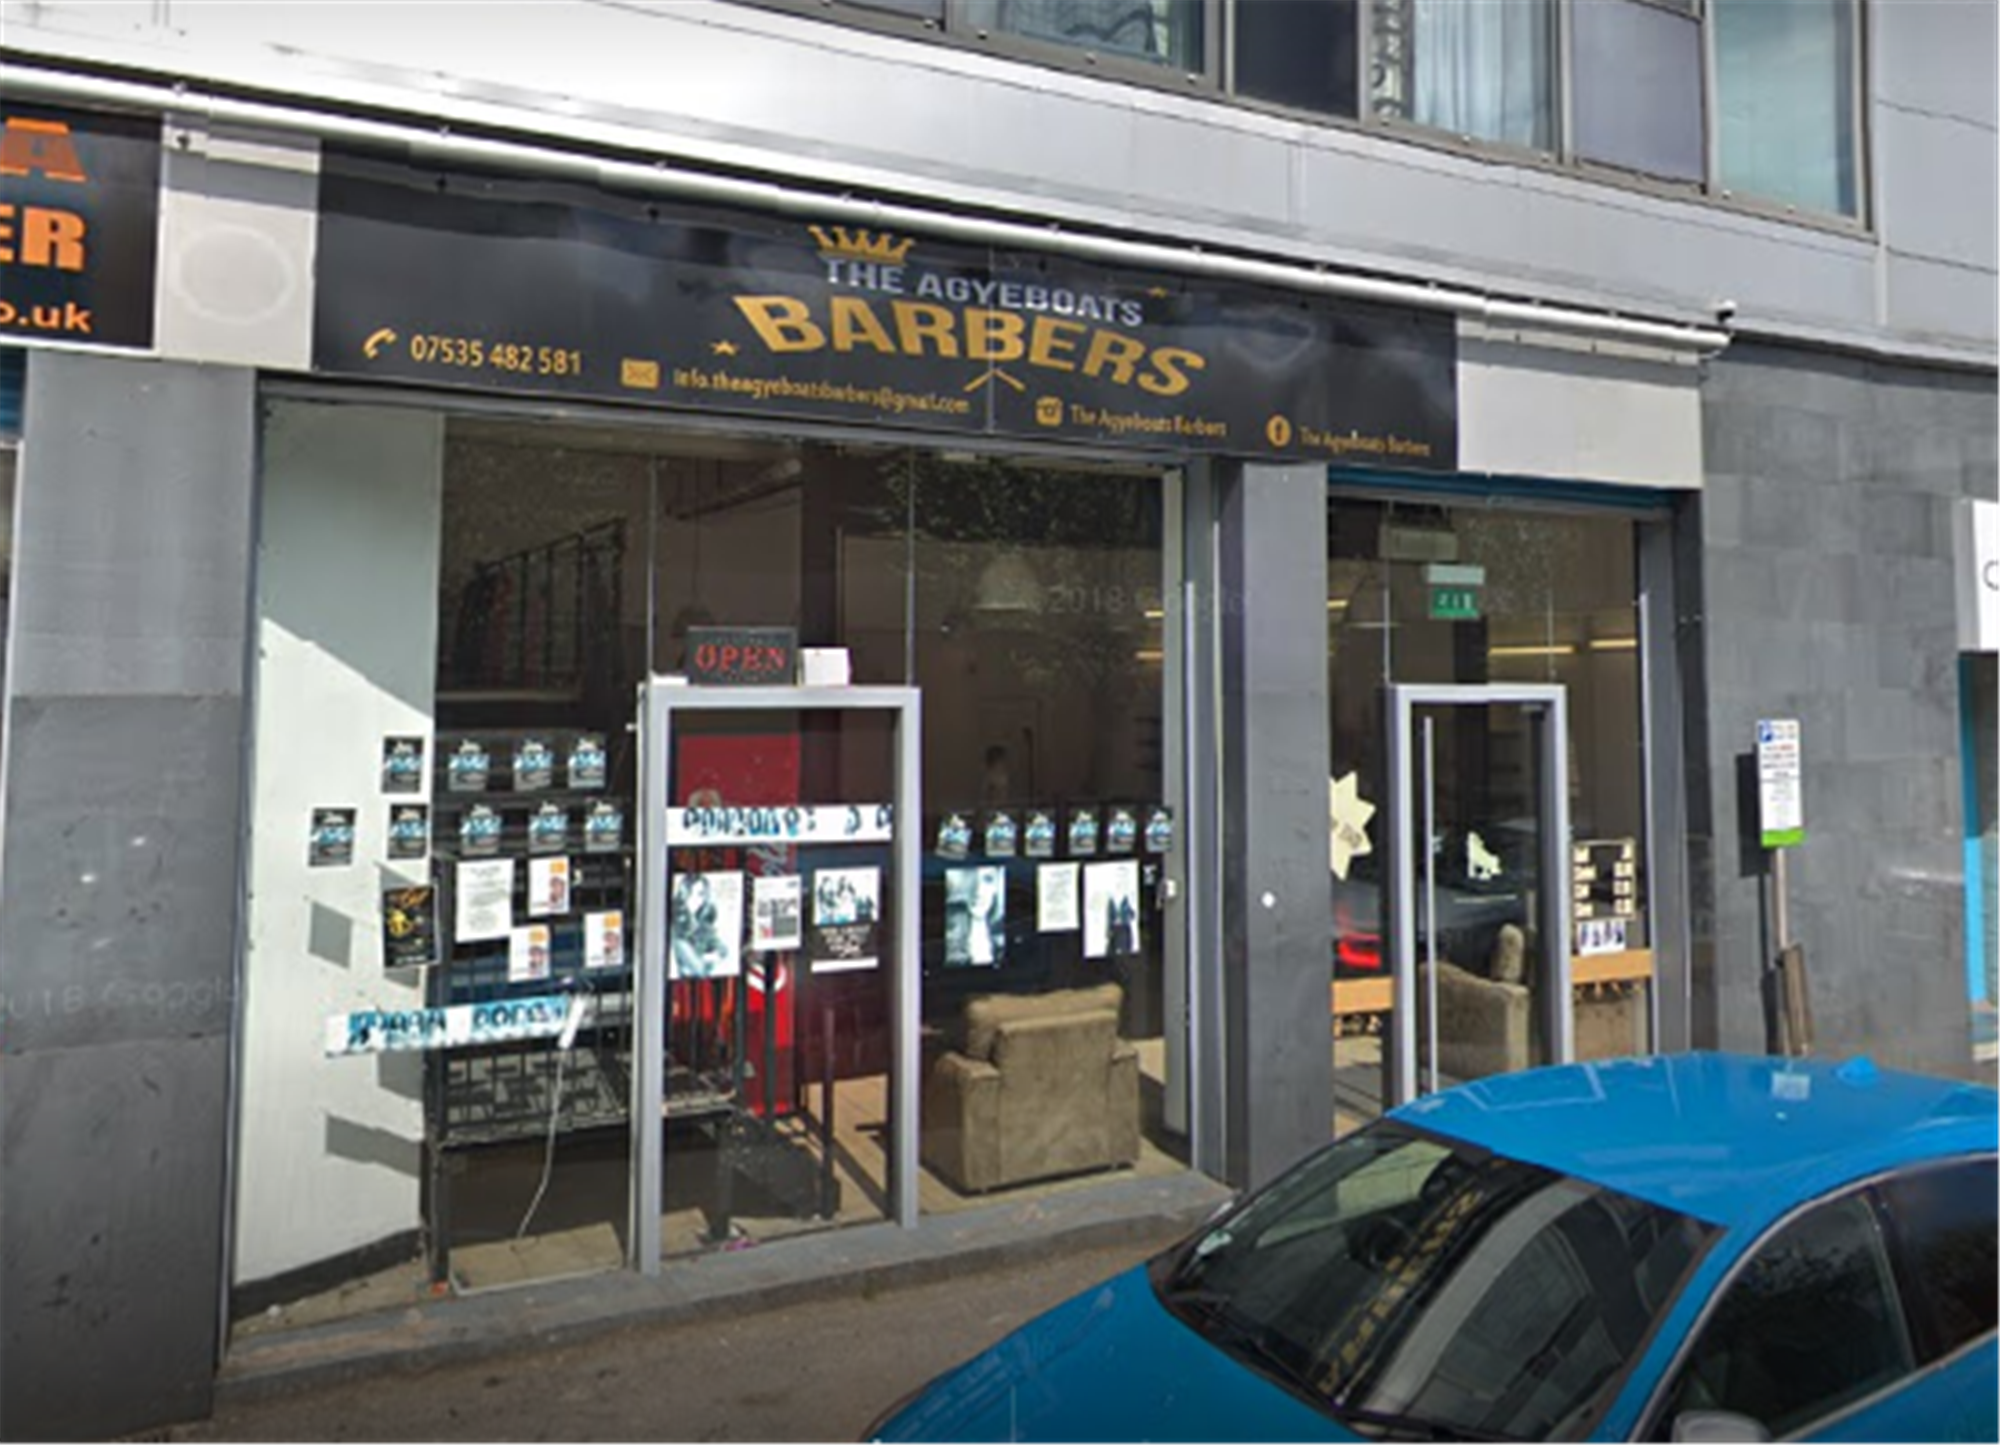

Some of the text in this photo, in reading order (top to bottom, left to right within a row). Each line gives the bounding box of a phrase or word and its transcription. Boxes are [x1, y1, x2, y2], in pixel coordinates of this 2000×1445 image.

[826, 259, 1144, 327] THE AGYEBOATS
[410, 334, 582, 375] 07535 482 581
[734, 295, 1206, 396] BARBERS
[1070, 404, 1096, 427] The
[694, 643, 786, 673] OPEN
